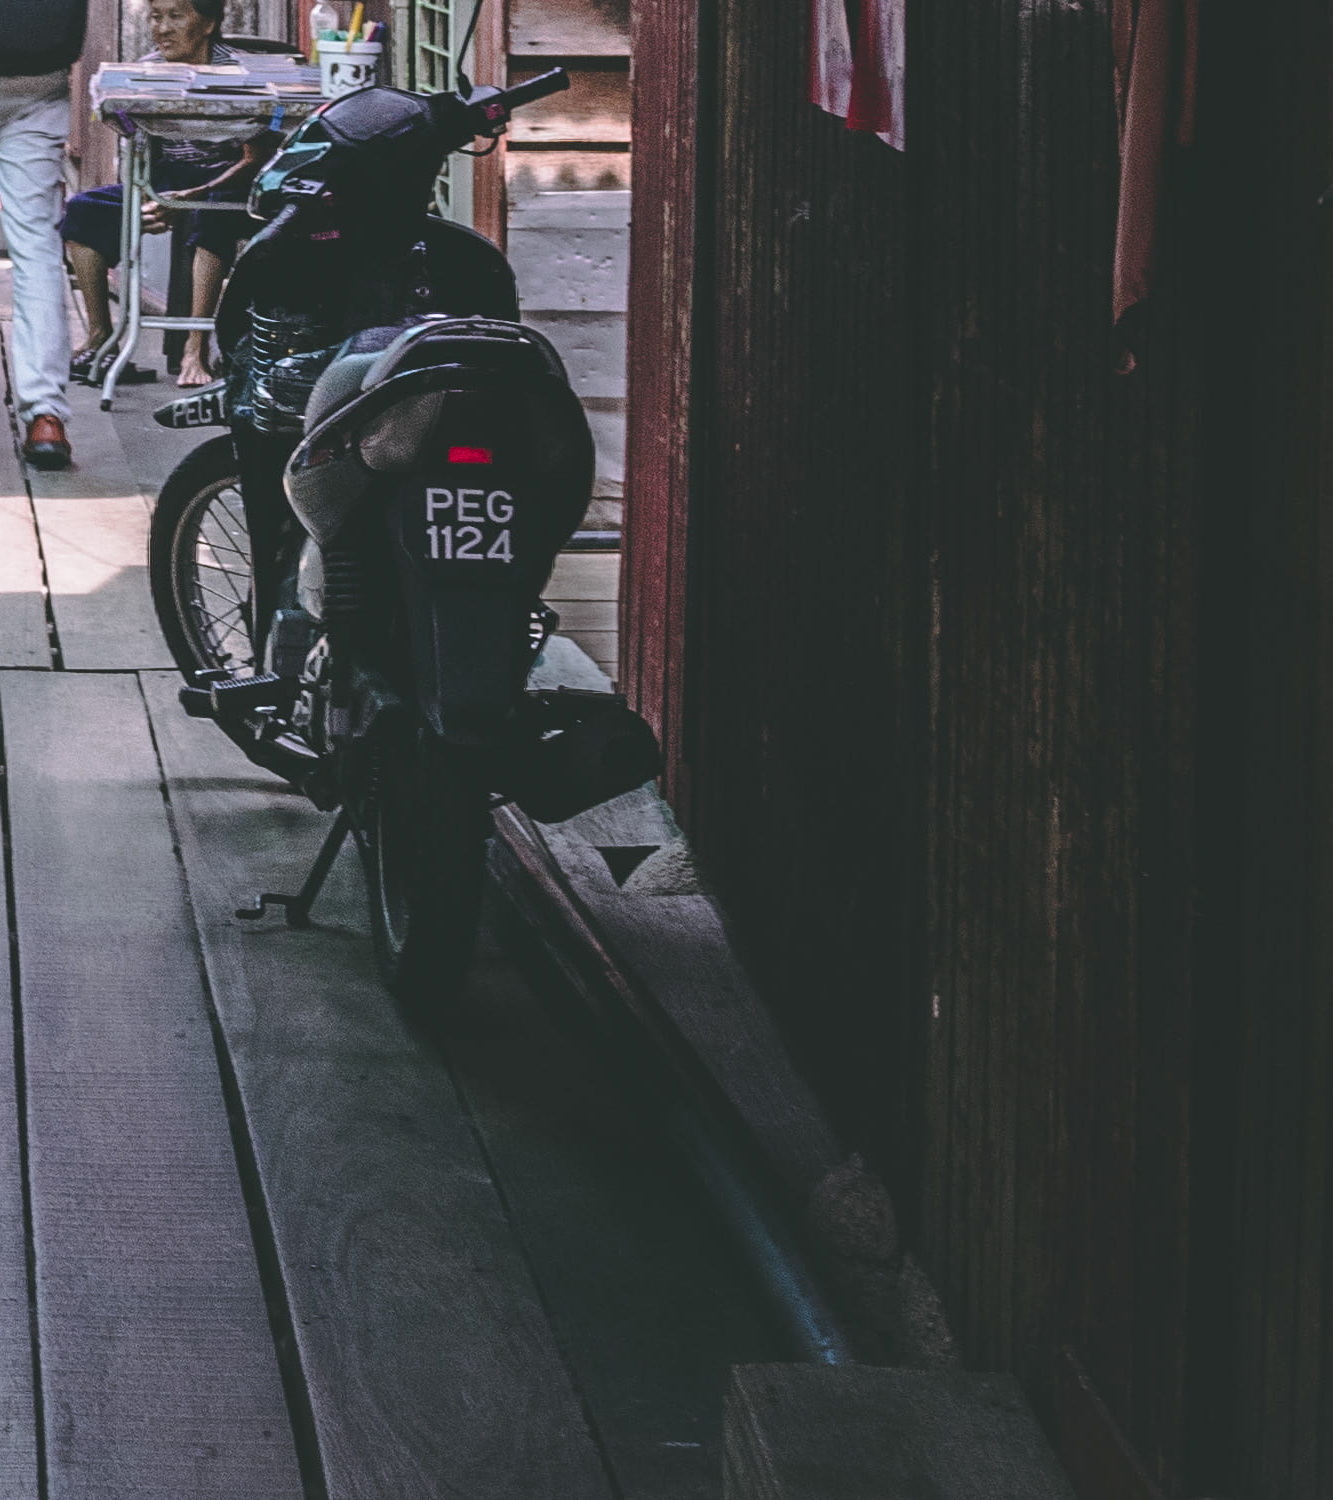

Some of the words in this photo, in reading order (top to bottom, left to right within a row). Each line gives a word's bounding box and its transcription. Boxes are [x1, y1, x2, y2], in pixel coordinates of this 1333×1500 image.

[172, 396, 214, 427] PEG
[426, 487, 514, 522] PEG
[425, 525, 514, 563] 1124
